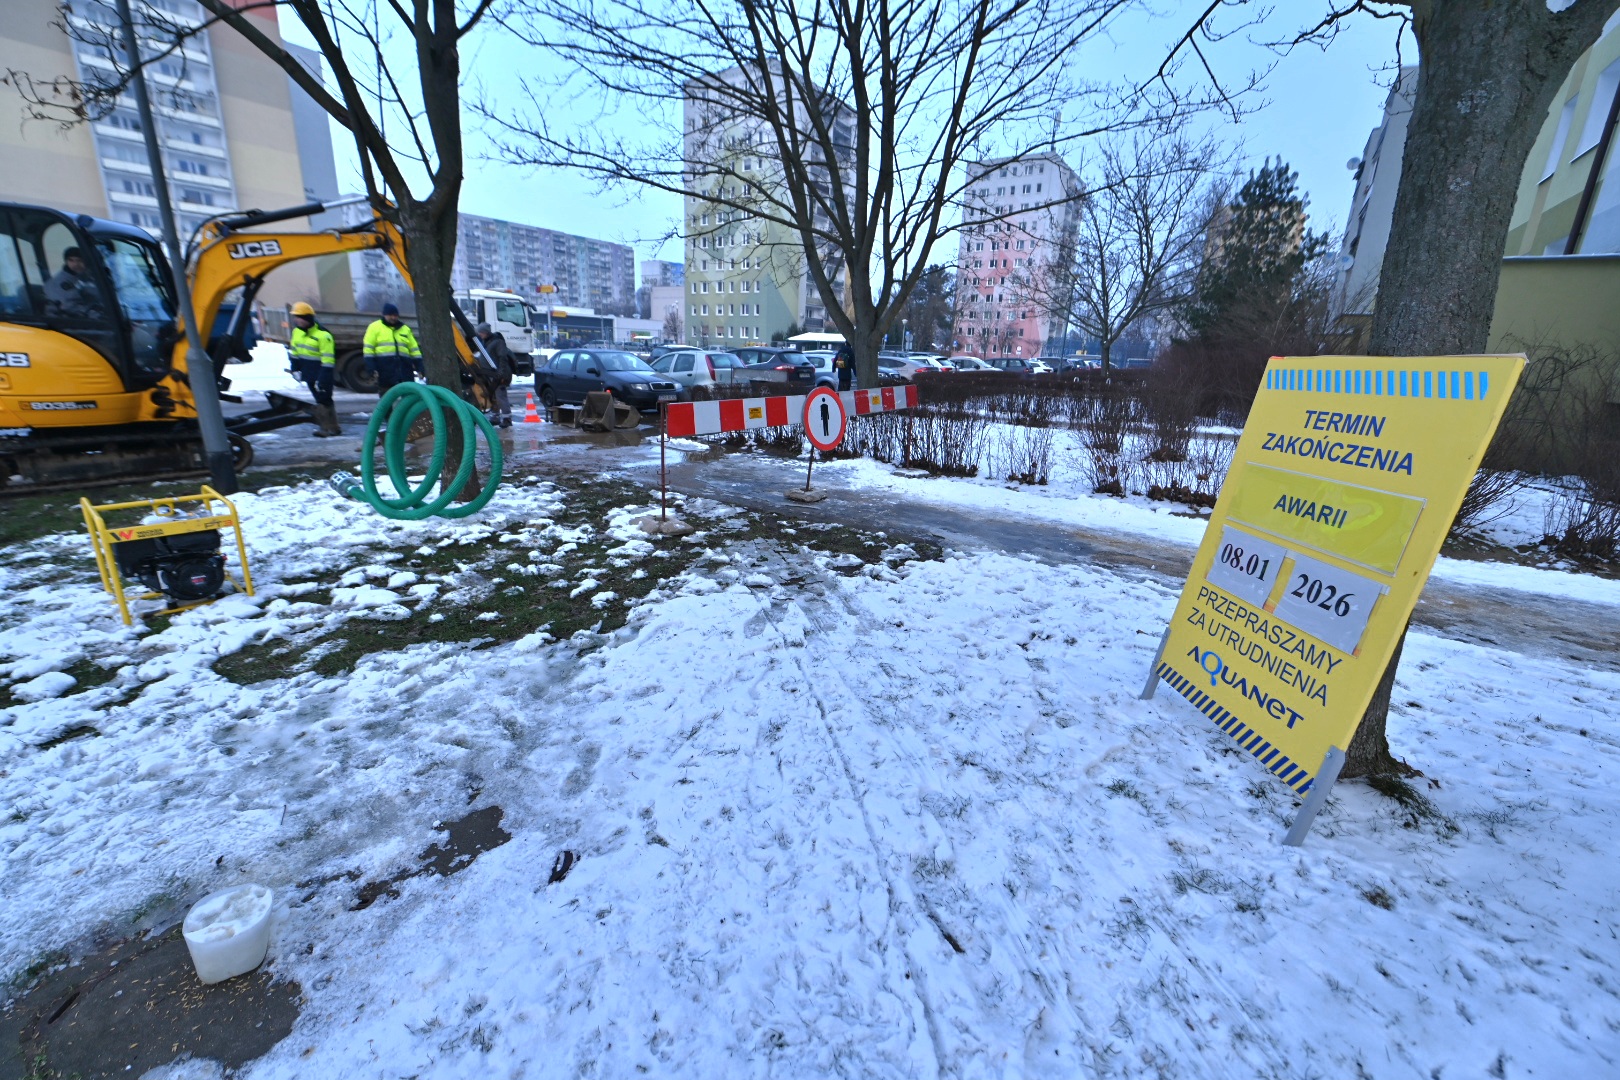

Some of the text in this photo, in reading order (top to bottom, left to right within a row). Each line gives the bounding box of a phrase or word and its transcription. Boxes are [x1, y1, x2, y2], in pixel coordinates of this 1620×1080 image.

[230, 240, 281, 259] JCB
[1304, 410, 1386, 437] TERMIN
[1261, 432, 1413, 476] ZAKOŃCZENIA
[1273, 494, 1348, 528] AWARII
[1220, 543, 1356, 617] 08.01 2026
[1197, 586, 1342, 675] PRZEPRASZAMY
[1208, 618, 1328, 707] UTRUDNIENIA
